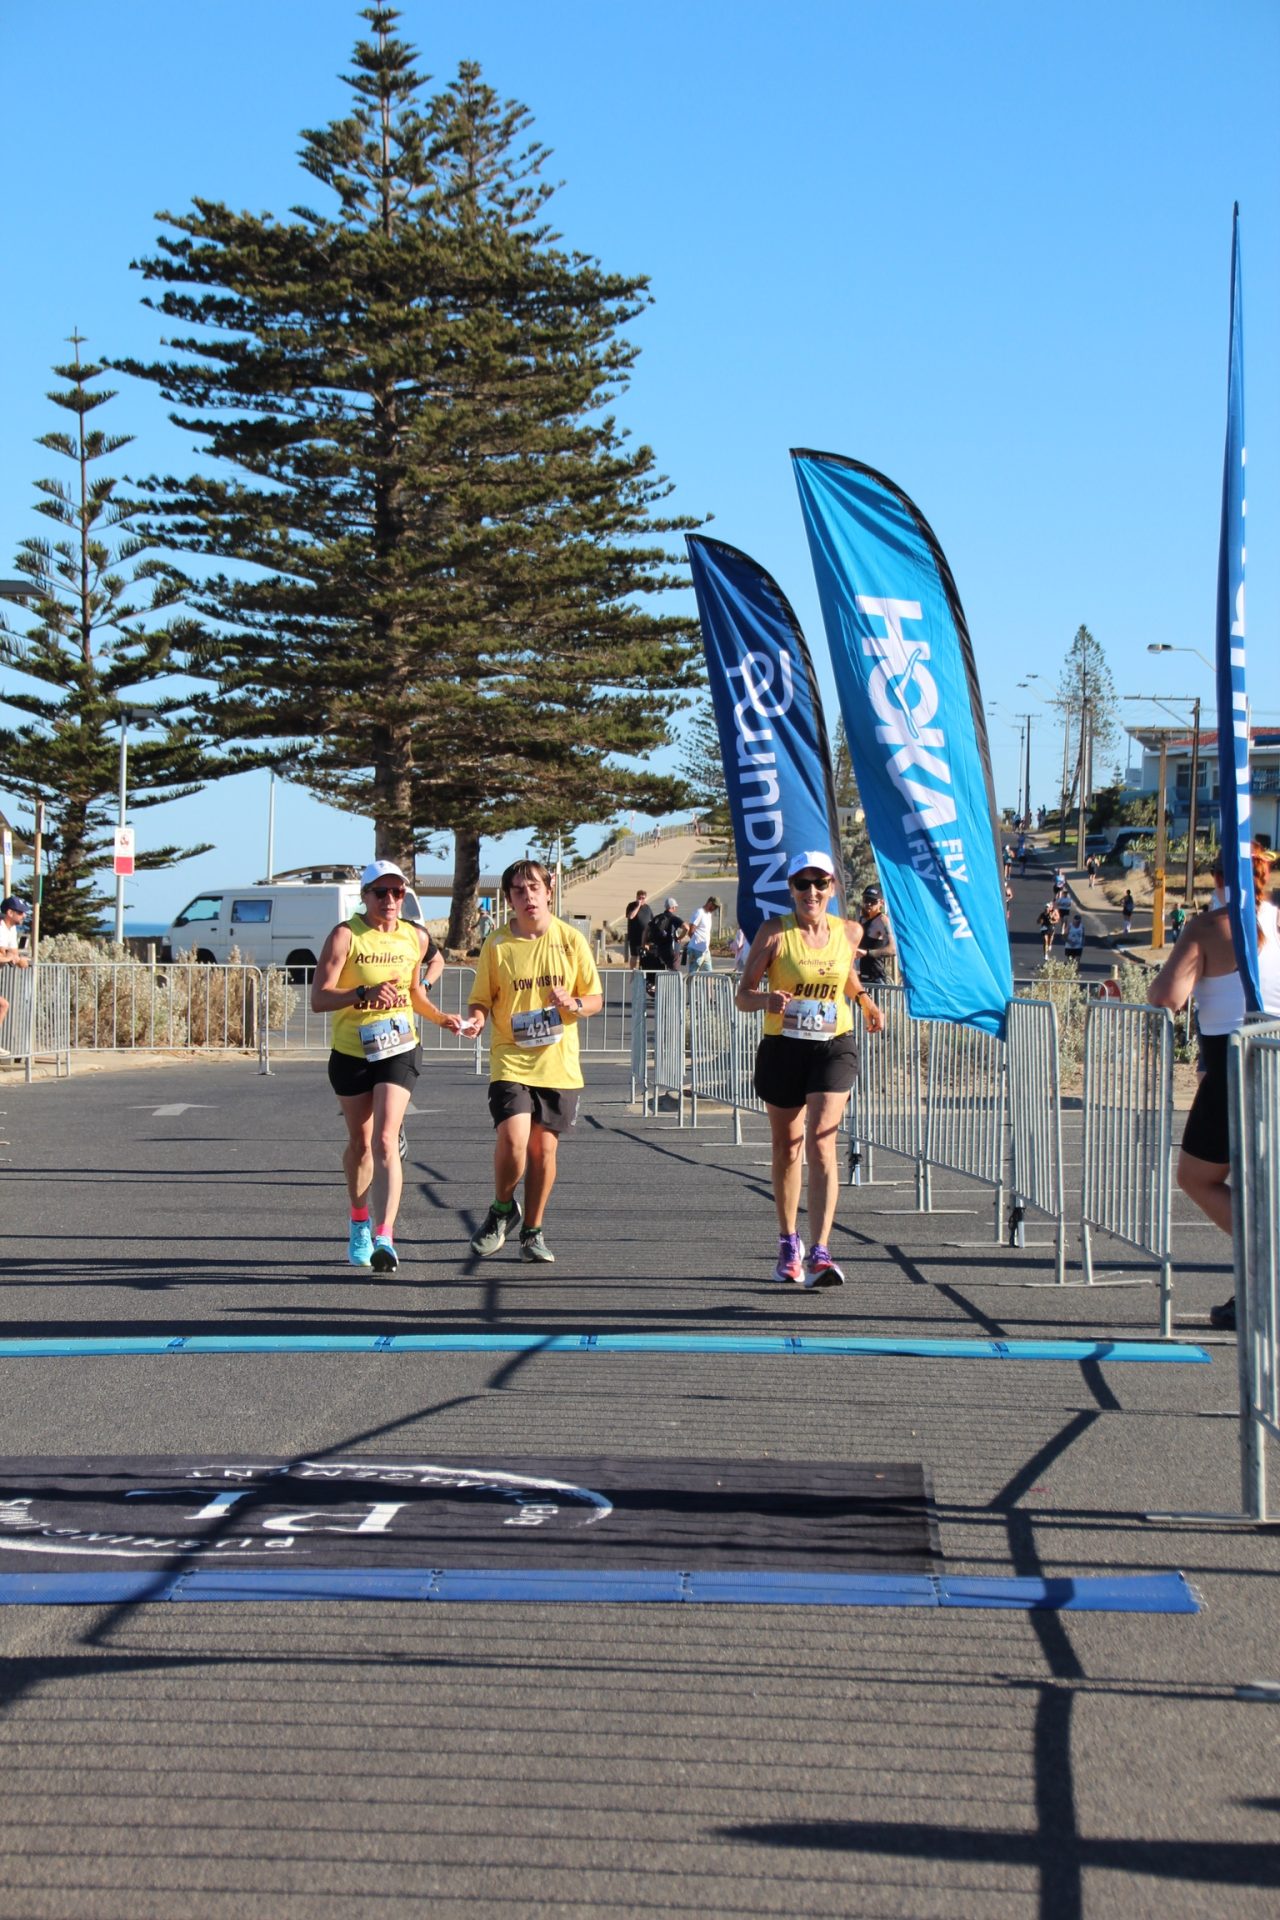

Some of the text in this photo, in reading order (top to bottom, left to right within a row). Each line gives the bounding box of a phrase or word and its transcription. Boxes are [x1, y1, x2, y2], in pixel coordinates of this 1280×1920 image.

[855, 595, 957, 835] HOKA
[908, 838, 937, 882] FLY
[941, 838, 969, 884] FLY
[355, 952, 404, 964] Achilles
[513, 975, 565, 991] LOW VISON
[793, 983, 837, 999] GUIDE
[527, 1020, 551, 1038] 421
[797, 1013, 824, 1031] 148
[374, 1029, 400, 1050] 128
[40, 1528, 296, 1549] PUSHING
